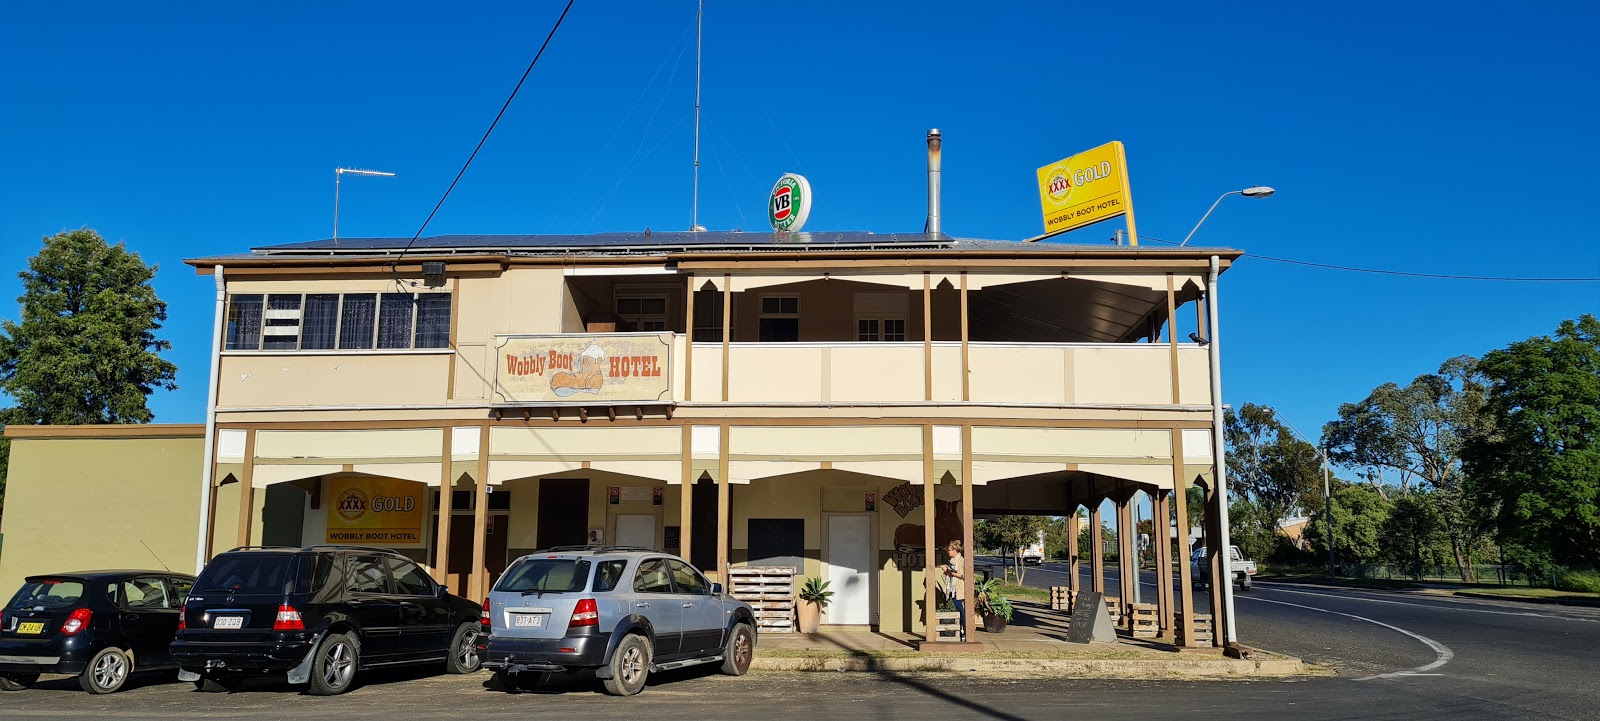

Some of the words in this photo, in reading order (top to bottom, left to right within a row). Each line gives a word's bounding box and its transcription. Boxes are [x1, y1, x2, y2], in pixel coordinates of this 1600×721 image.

[1048, 178, 1071, 195] XXXX
[1074, 161, 1111, 187] GOLD
[774, 194, 790, 211] VB
[1047, 211, 1075, 226] WOBBLY
[1076, 205, 1096, 217] BOOT
[1097, 198, 1120, 211] HOTEL
[506, 353, 546, 376] Wobbly
[549, 350, 573, 371] Boot
[609, 355, 661, 377] HOTEL
[339, 499, 366, 510] XXXX
[371, 495, 415, 512] GOLD
[330, 532, 364, 540] WOBBLY
[366, 532, 389, 540] BOOT
[390, 532, 417, 540] HOTEL
